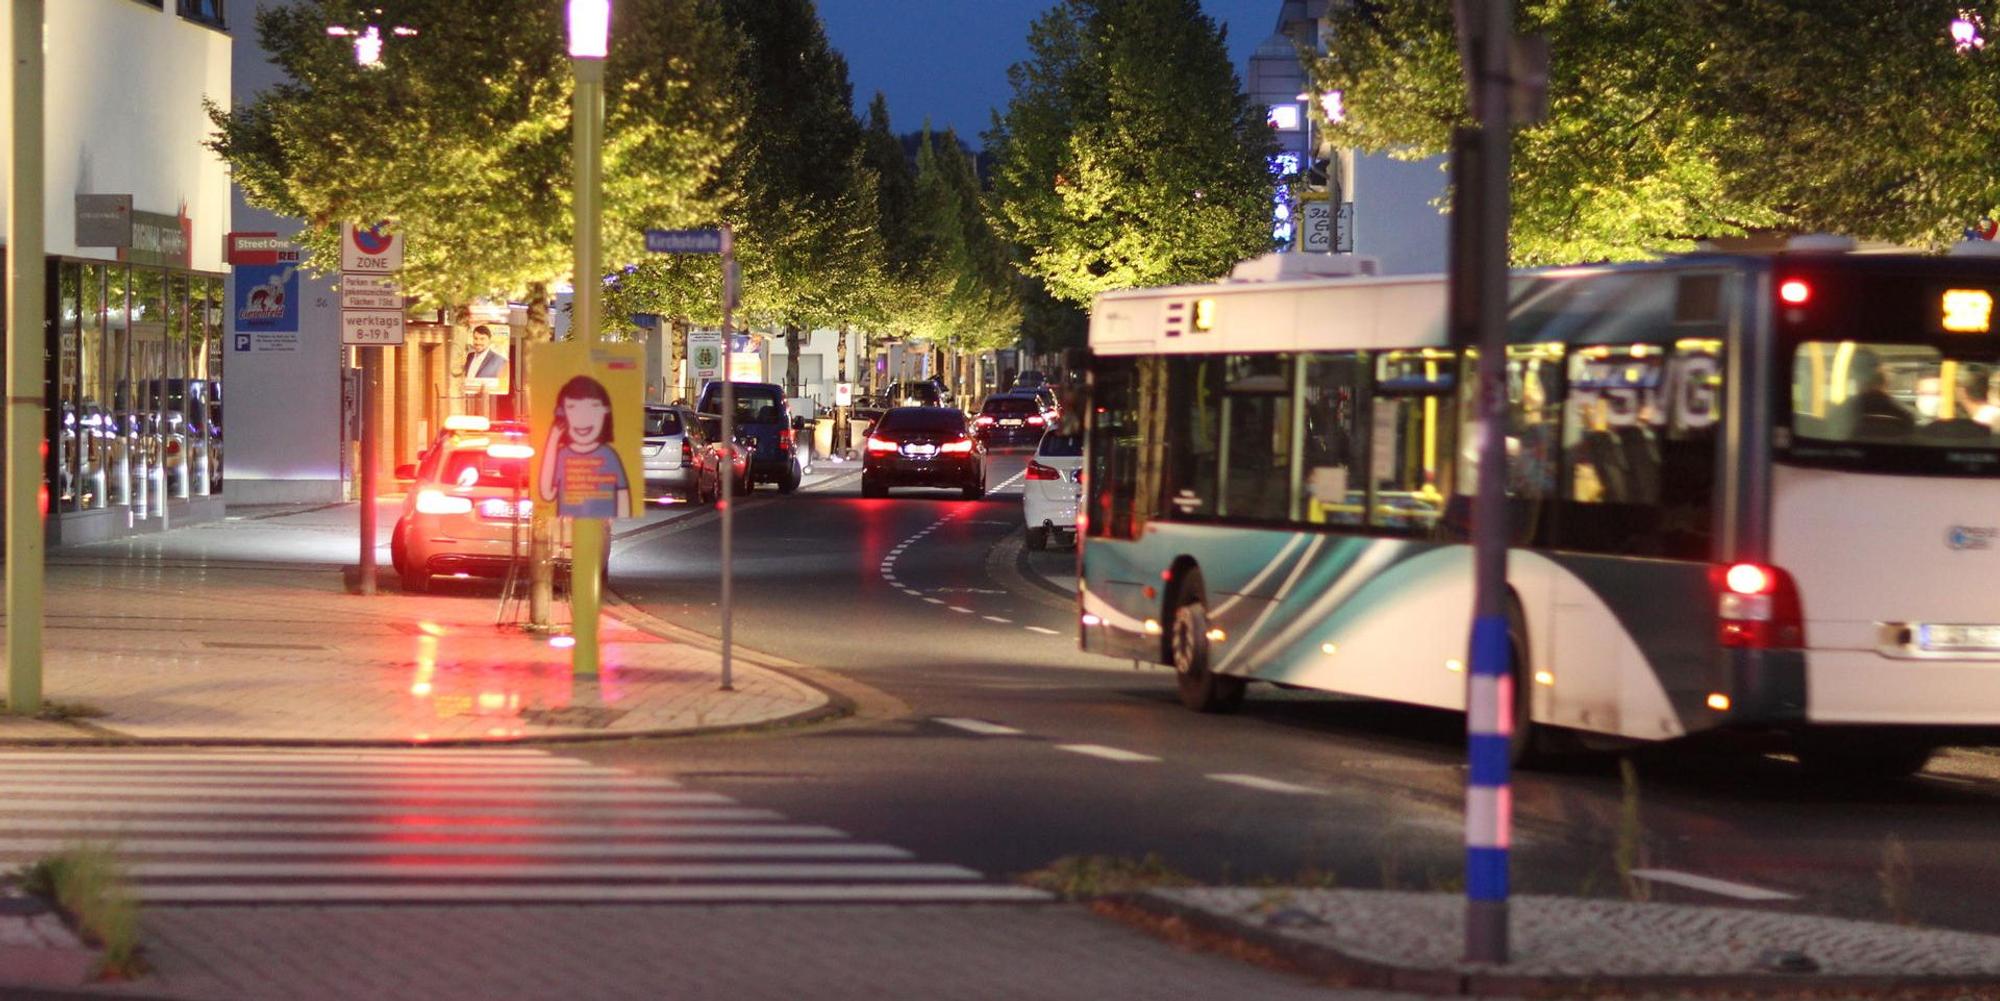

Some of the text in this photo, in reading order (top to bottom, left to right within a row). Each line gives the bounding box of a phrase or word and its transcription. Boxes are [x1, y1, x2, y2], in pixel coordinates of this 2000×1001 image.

[238, 239, 290, 249] Street One
[356, 257, 389, 268] ZONE
[345, 315, 400, 329] werktags
